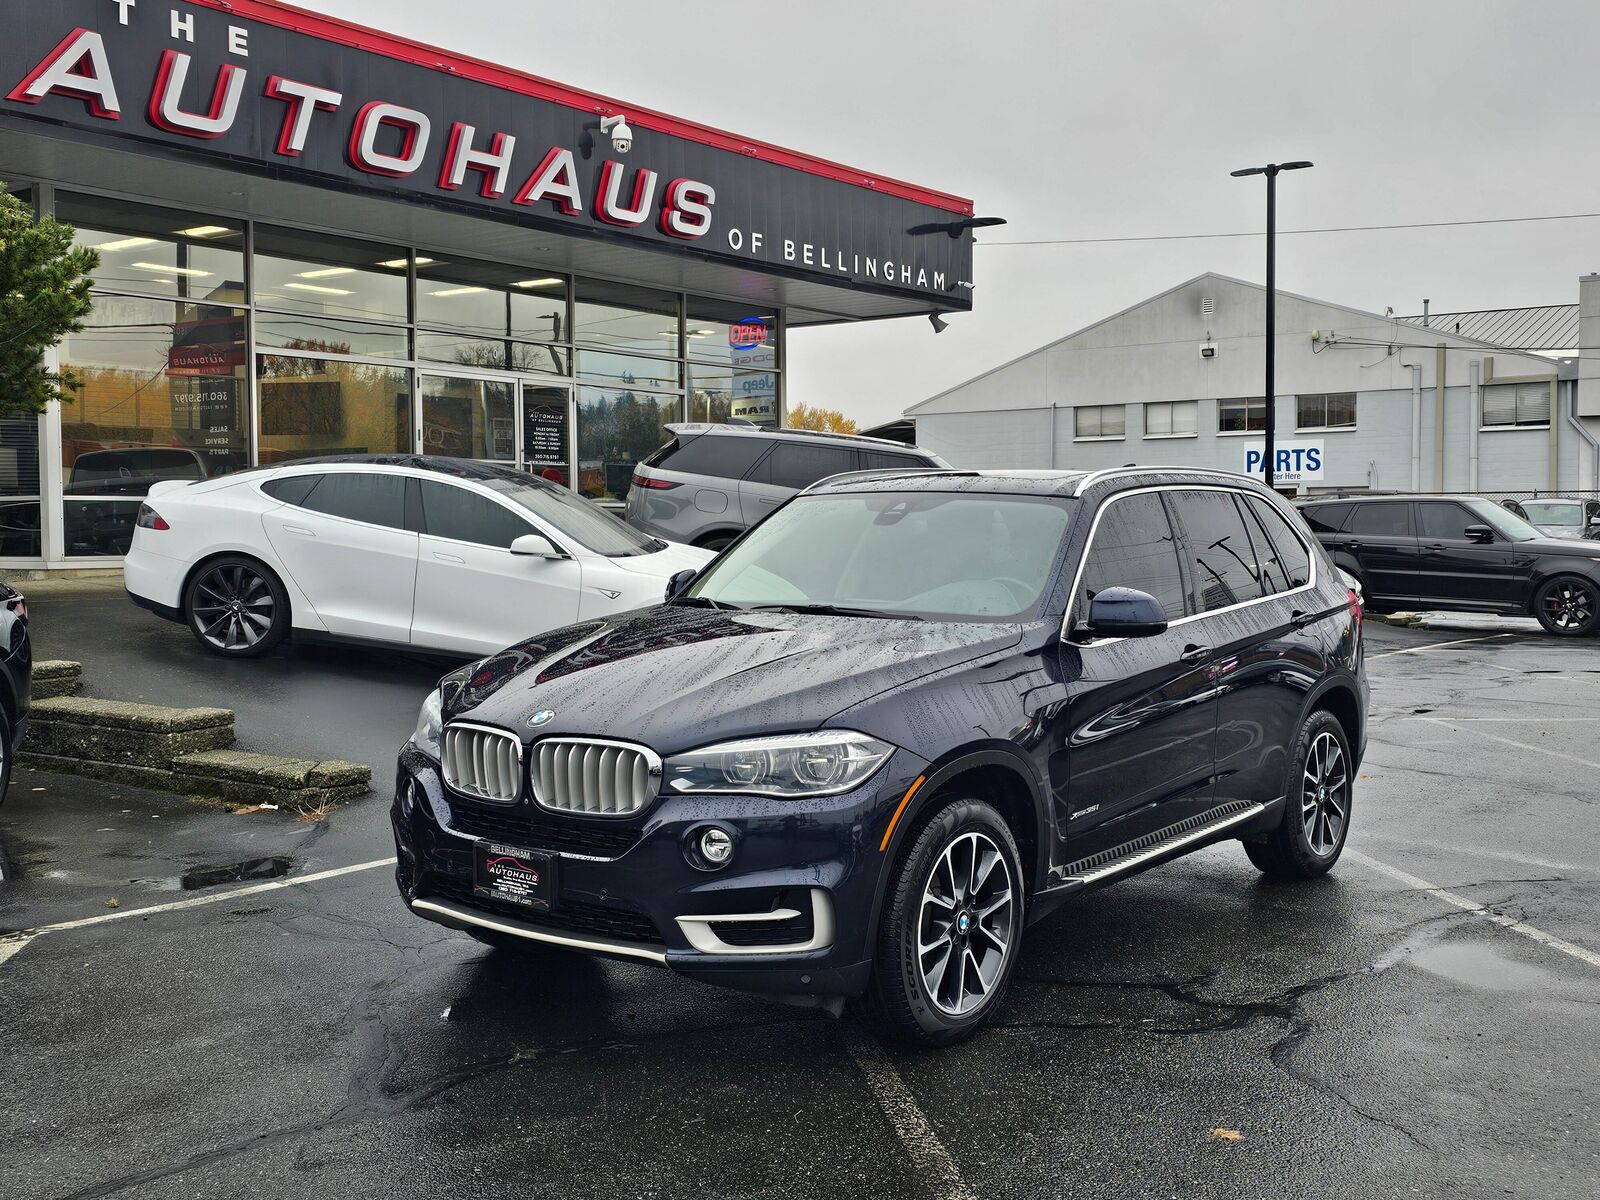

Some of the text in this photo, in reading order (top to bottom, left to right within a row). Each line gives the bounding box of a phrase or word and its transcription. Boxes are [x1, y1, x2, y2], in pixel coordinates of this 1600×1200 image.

[112, 0, 250, 57] THE
[3, 27, 717, 240] AUTOHAUS
[728, 228, 945, 291] OF BELLINGHAM
[729, 324, 768, 344] OPEN
[530, 412, 563, 420] AUTOHAUS
[1284, 472, 1302, 480] Here
[490, 845, 531, 860] BELLINGHAM
[489, 867, 538, 882] AUTOHAUS
